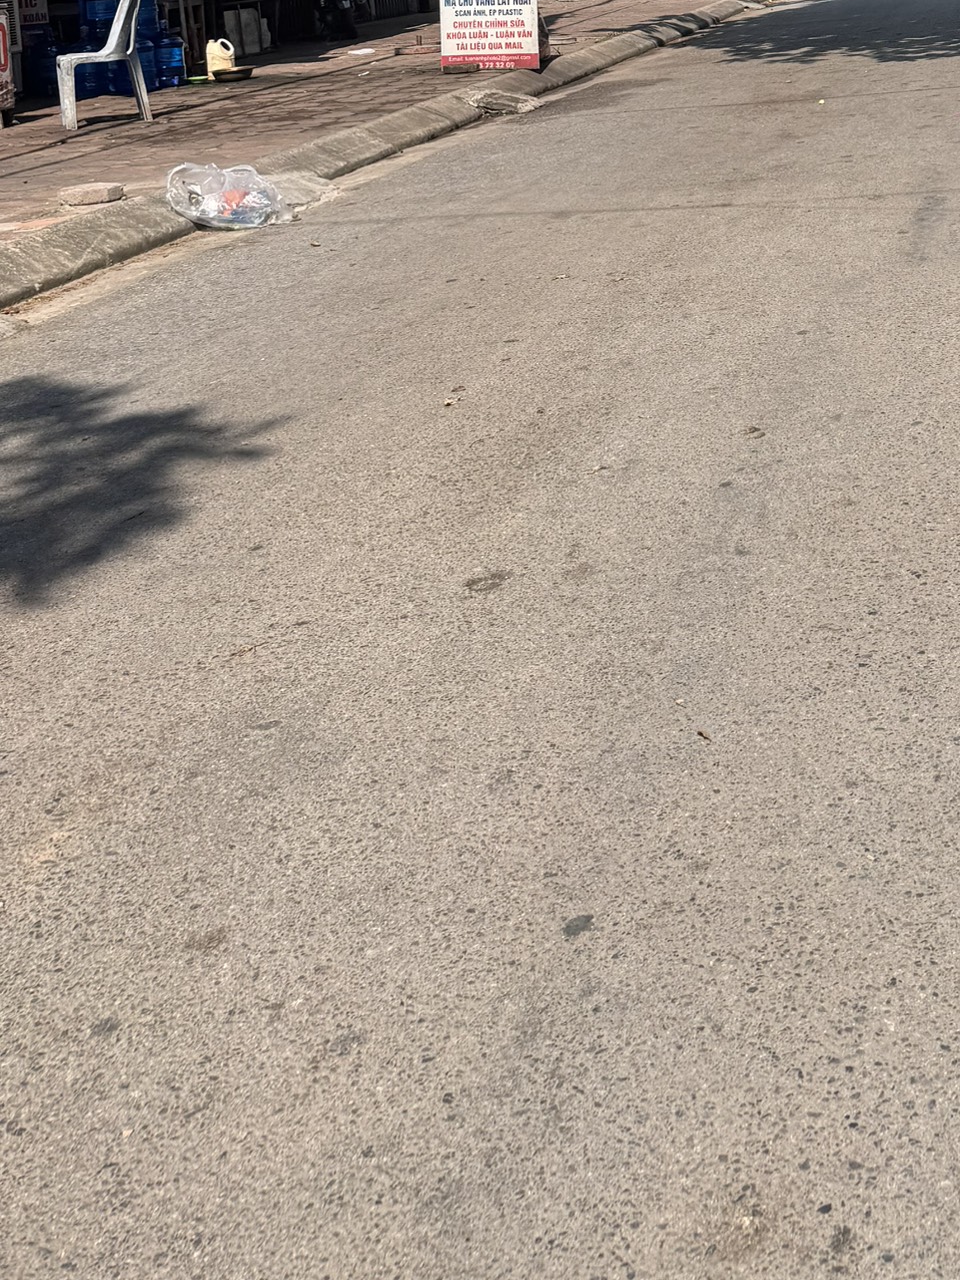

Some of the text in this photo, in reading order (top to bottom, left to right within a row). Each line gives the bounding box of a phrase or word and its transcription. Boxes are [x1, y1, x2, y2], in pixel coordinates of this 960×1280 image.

[453, 17, 526, 29] CHUYÊN CHỈNH SỬA
[469, 30, 489, 40] LUẬN
[495, 30, 516, 40] LUẬN
[517, 29, 533, 38] VĂN
[456, 41, 524, 52] TÀI LIỆU QUA MAIL
